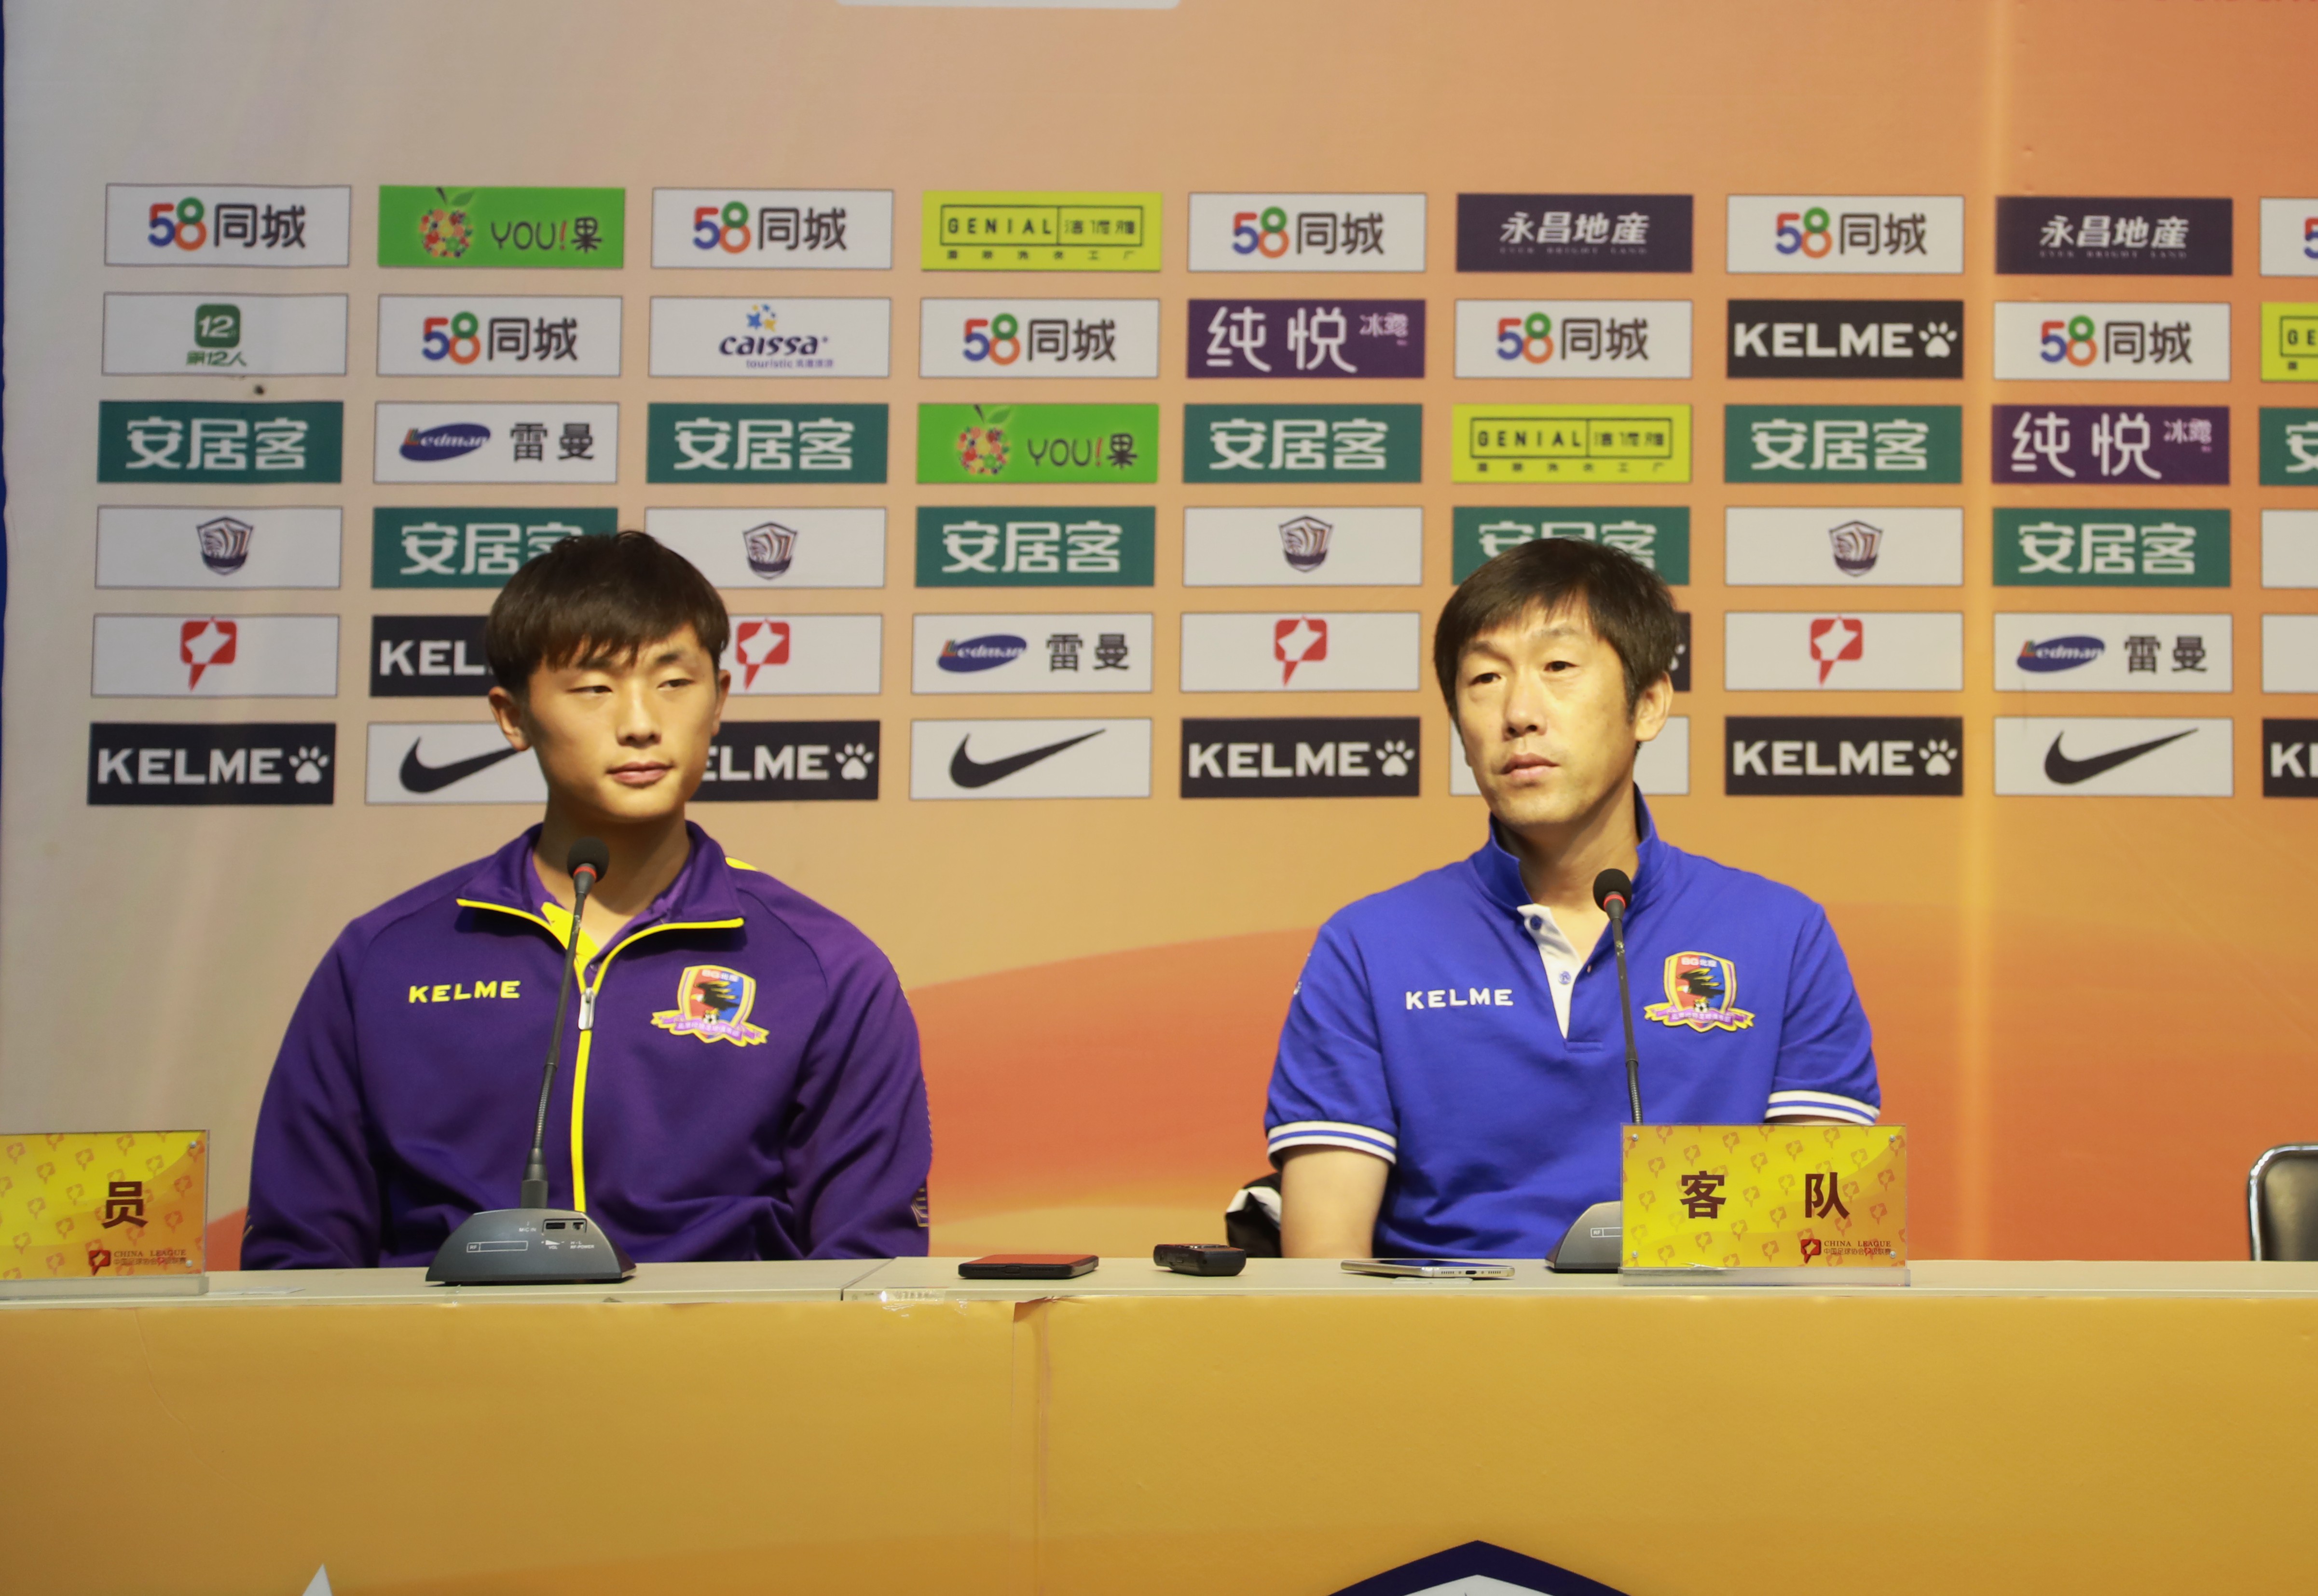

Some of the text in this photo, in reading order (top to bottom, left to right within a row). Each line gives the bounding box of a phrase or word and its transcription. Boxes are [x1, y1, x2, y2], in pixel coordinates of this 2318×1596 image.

[148, 197, 306, 251] 58同城
[693, 201, 847, 254] 58同城
[948, 217, 1051, 235] GENIAL
[1232, 206, 1384, 258] 58同城
[1775, 207, 1927, 258] 58同城
[199, 315, 234, 338] 12
[422, 312, 577, 364] 58同城
[719, 336, 818, 356] caissa
[963, 313, 1116, 365] 58同城
[1497, 313, 1648, 364] 58同城
[1734, 323, 1914, 358] KELME
[2041, 316, 2192, 366] 58同城
[126, 417, 309, 470] 安居客
[510, 423, 594, 462] 雷曼
[673, 417, 855, 470] 安居客
[1209, 418, 1388, 470] 安居客
[1478, 430, 1580, 448] GENIAL
[1751, 418, 1929, 470] 安居客
[942, 520, 1122, 573] 安居客
[2018, 522, 2196, 574] 安居客
[380, 640, 487, 676] KEL
[1046, 633, 1129, 672] 雷曼
[2124, 635, 2207, 674] 雷曼
[97, 748, 283, 784] KELME
[1188, 742, 1371, 778] KELME
[1733, 741, 1914, 776] KELME
[409, 980, 521, 1004] KELME
[1405, 988, 1514, 1010] KELME
[101, 1181, 149, 1229] 员
[1680, 1170, 1851, 1220] 客队
